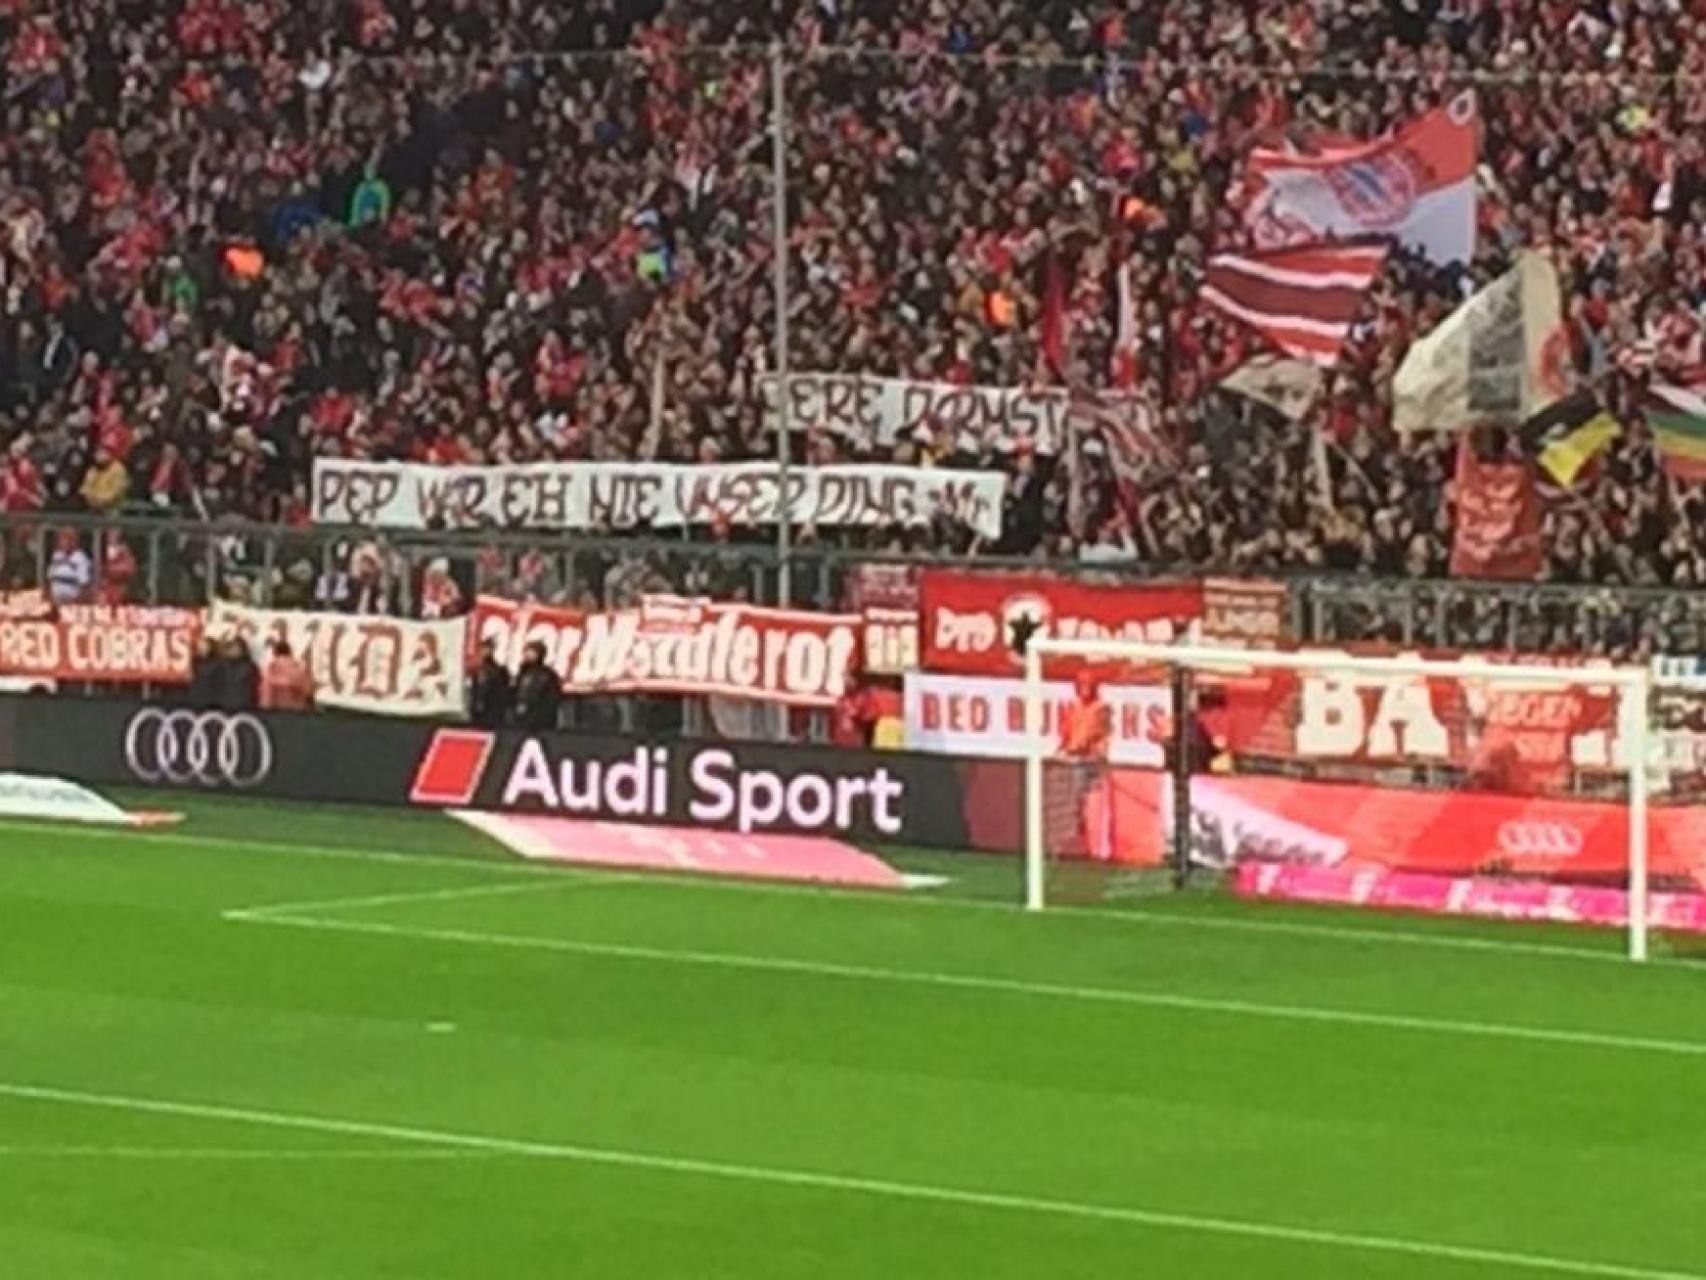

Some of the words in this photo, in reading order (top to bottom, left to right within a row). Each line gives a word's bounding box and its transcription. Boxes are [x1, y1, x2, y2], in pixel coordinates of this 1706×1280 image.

[318, 470, 398, 522] PEP
[67, 625, 191, 672] COBRAS
[503, 737, 668, 815] Audi
[689, 749, 905, 834] Sport
